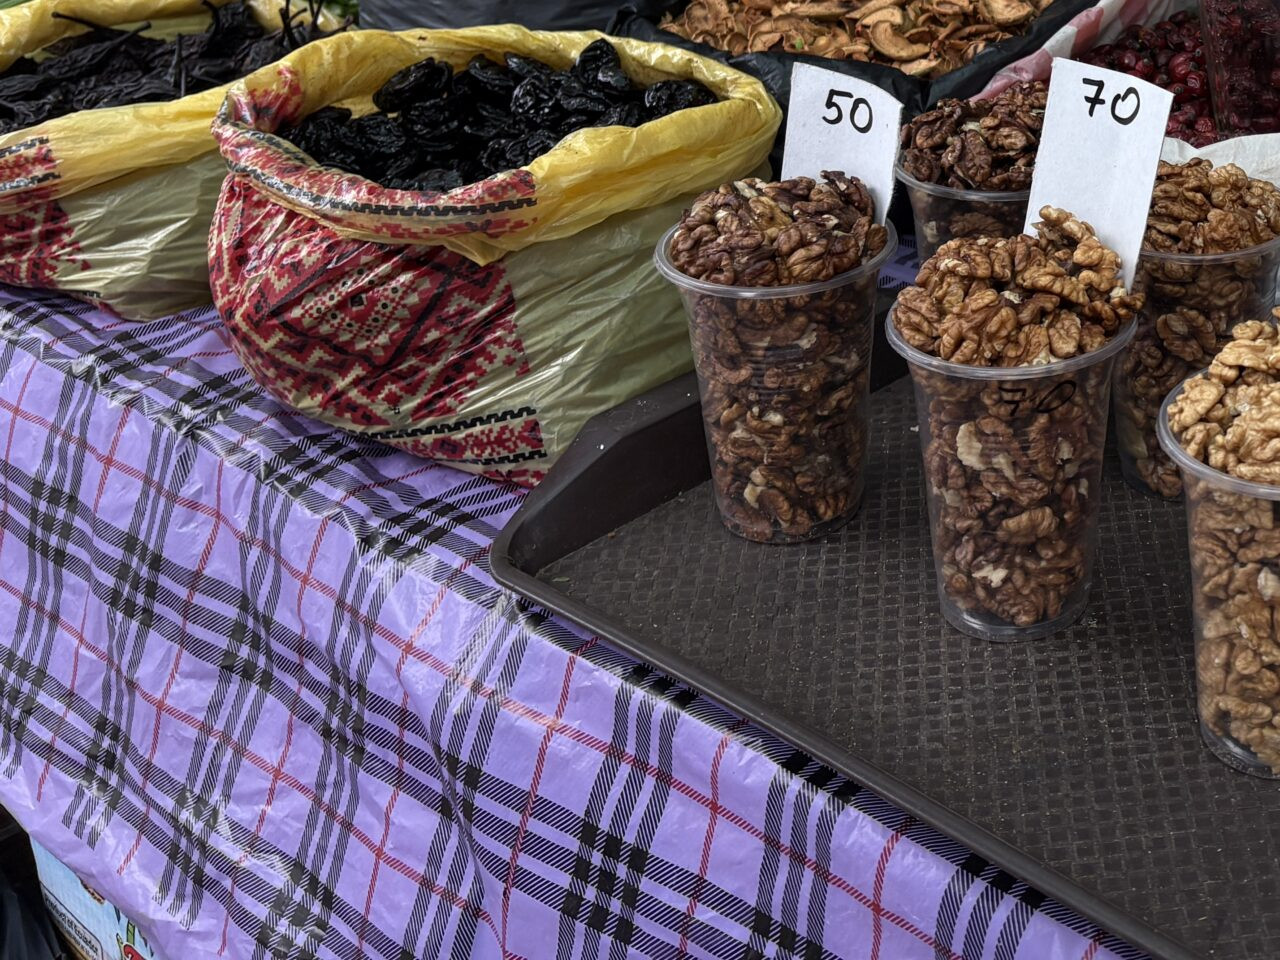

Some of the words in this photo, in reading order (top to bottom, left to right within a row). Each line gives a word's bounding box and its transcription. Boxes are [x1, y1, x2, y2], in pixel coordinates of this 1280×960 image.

[822, 89, 873, 134] 50
[1082, 77, 1141, 126] 70
[998, 379, 1077, 416] 70
